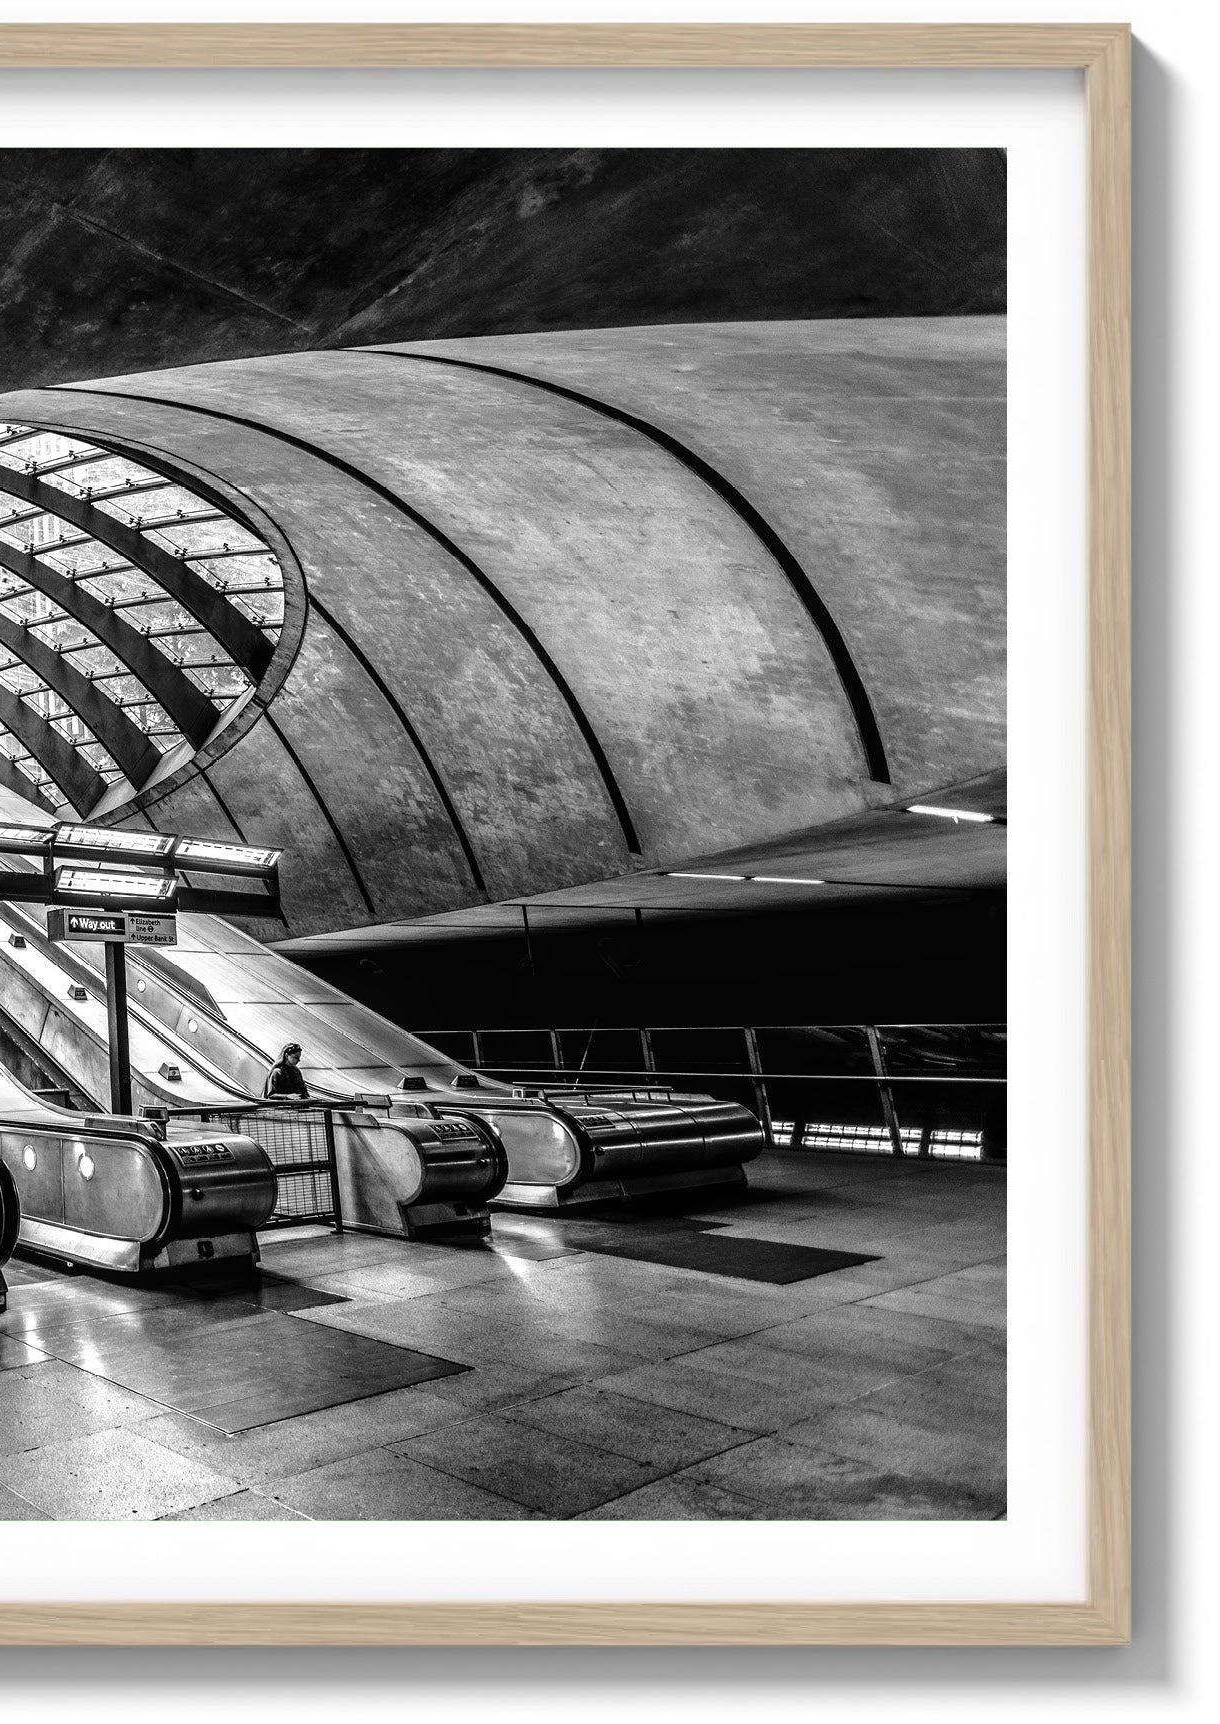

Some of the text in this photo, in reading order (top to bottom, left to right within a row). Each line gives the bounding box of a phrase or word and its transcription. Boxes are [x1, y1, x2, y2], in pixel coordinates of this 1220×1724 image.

[79, 917, 115, 930] Way out
[135, 918, 160, 926] Elizabeth
[137, 934, 153, 942] Upper
